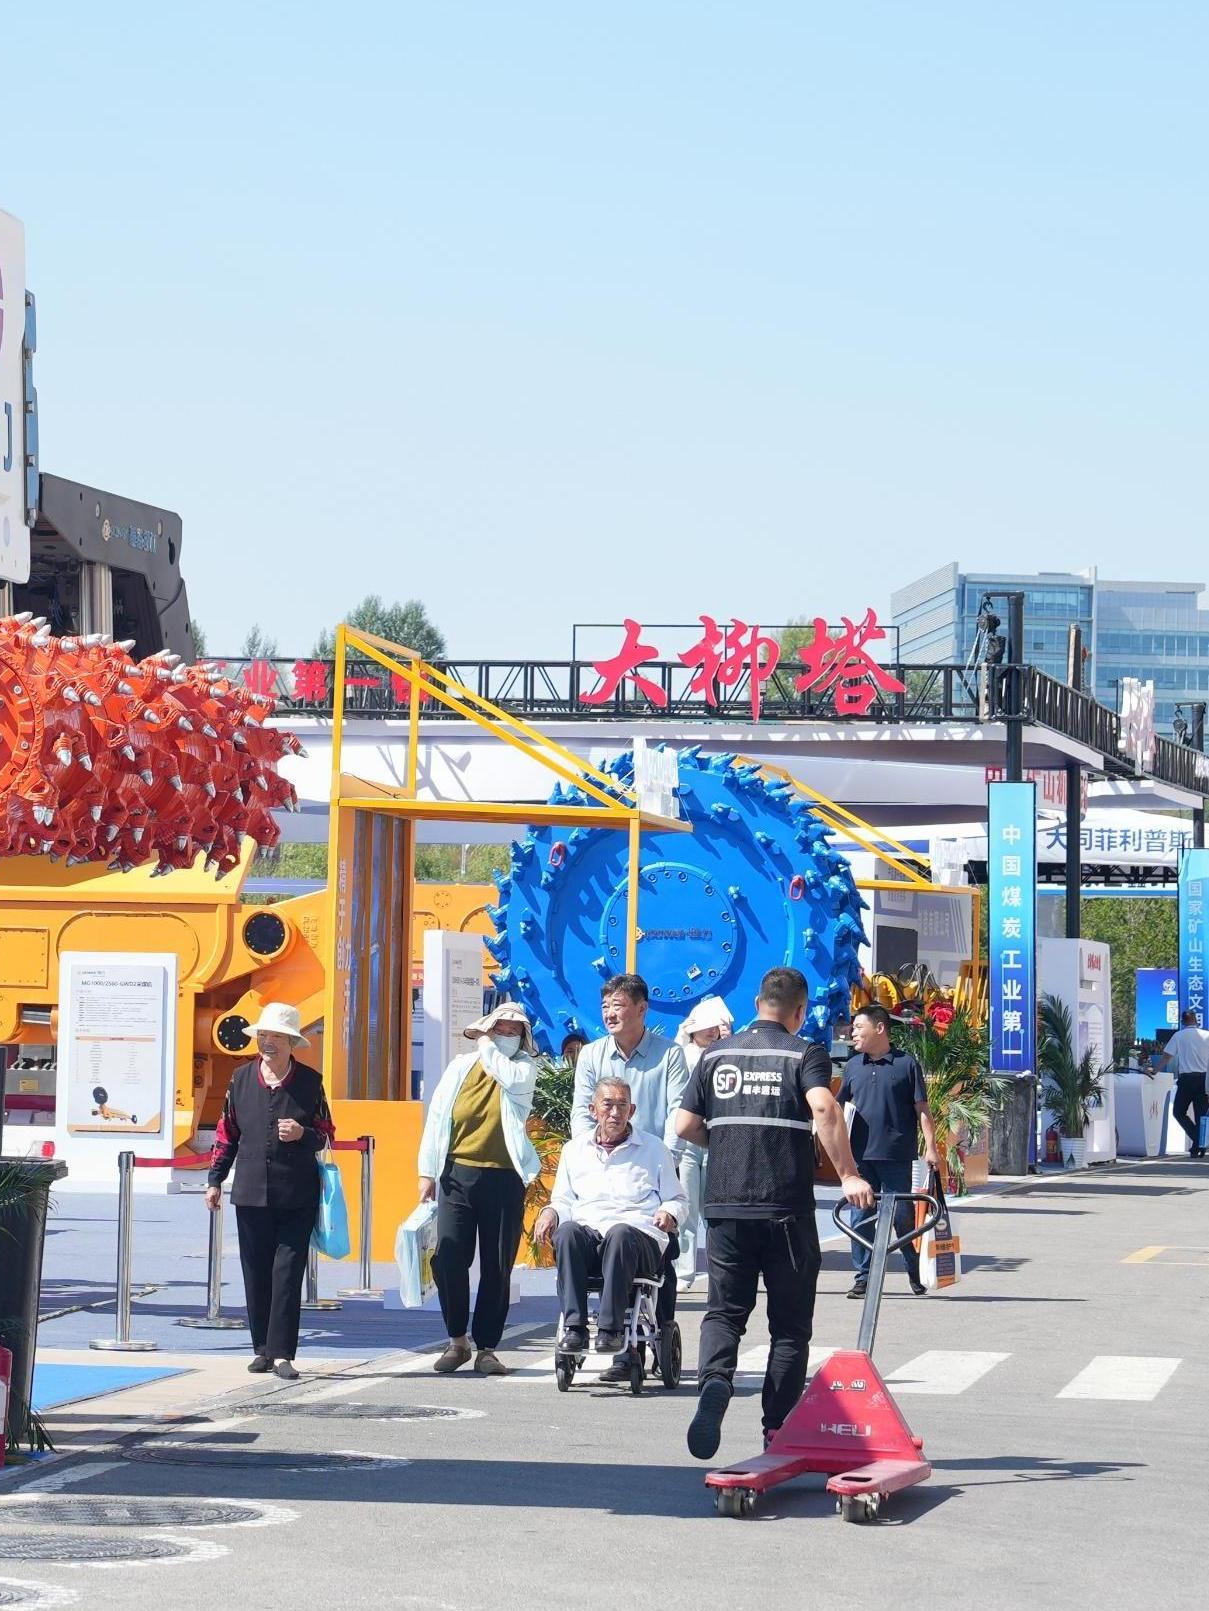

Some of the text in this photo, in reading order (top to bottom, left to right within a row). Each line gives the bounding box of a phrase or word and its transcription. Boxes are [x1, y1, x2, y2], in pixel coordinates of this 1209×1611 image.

[196, 657, 430, 704] 业第一
[578, 607, 906, 724] 大柳塔
[1001, 824, 1023, 1055] 中国煤炭工业第一
[743, 1071, 783, 1082] EXPRESS
